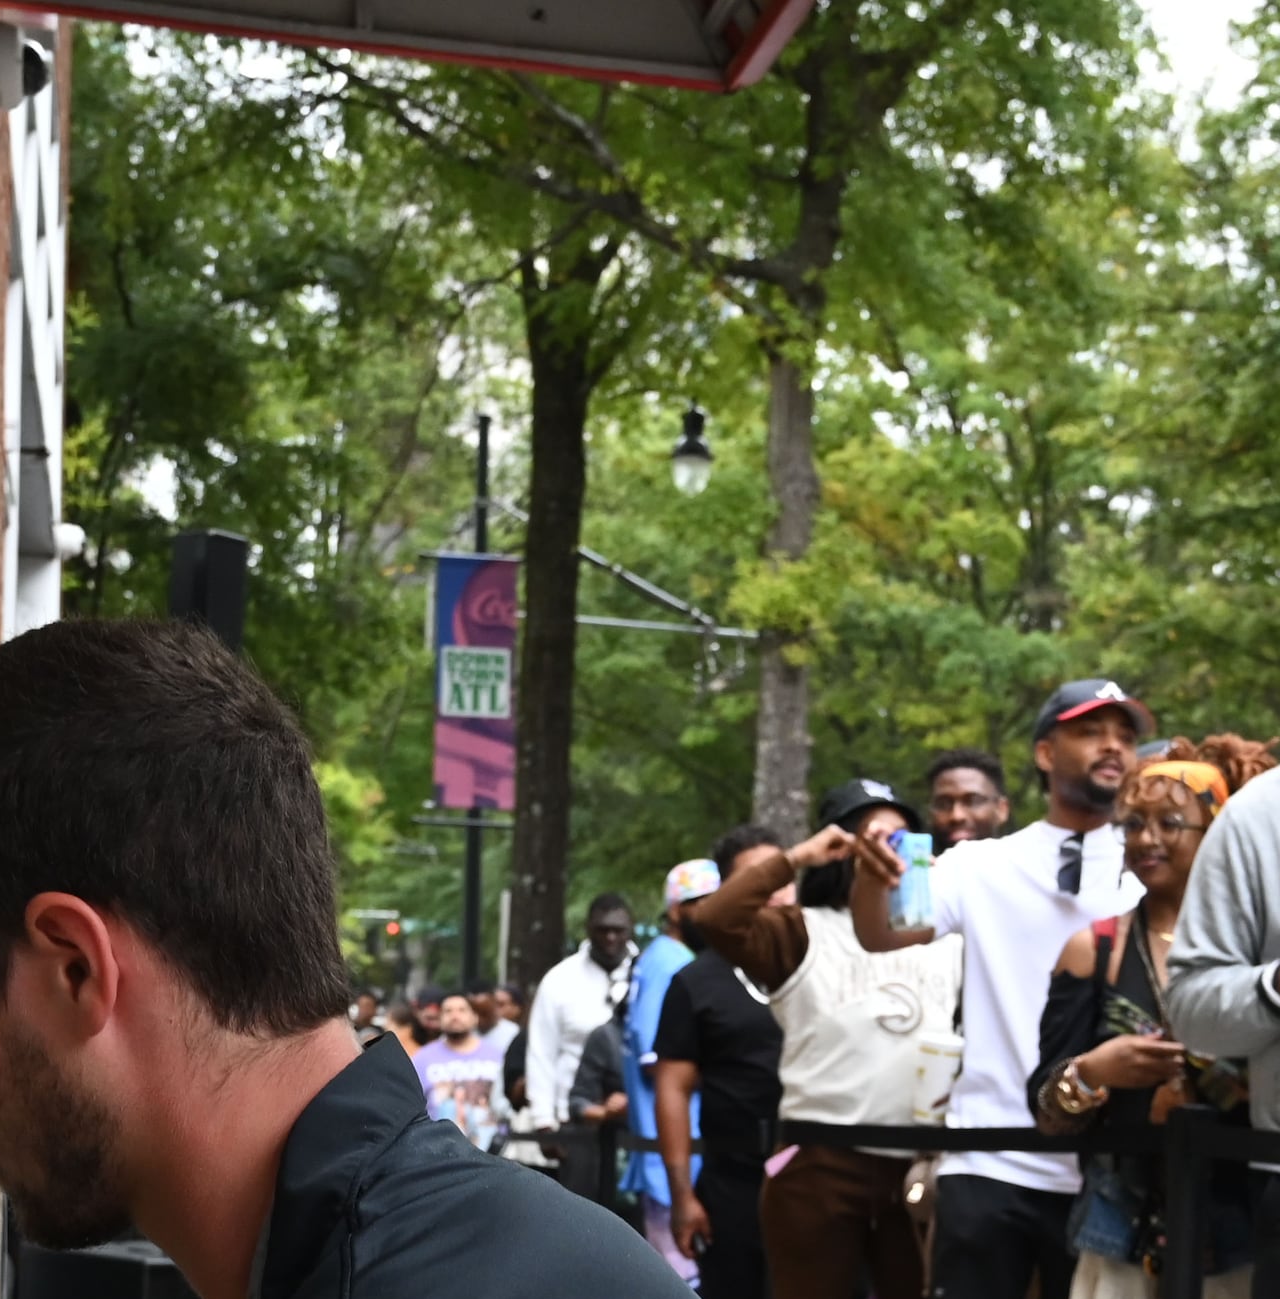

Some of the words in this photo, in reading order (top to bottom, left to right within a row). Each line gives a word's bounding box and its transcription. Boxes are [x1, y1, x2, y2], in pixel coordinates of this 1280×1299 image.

[448, 652, 505, 669] DOWN
[449, 669, 505, 683] TOWN
[447, 683, 505, 713] ATL
